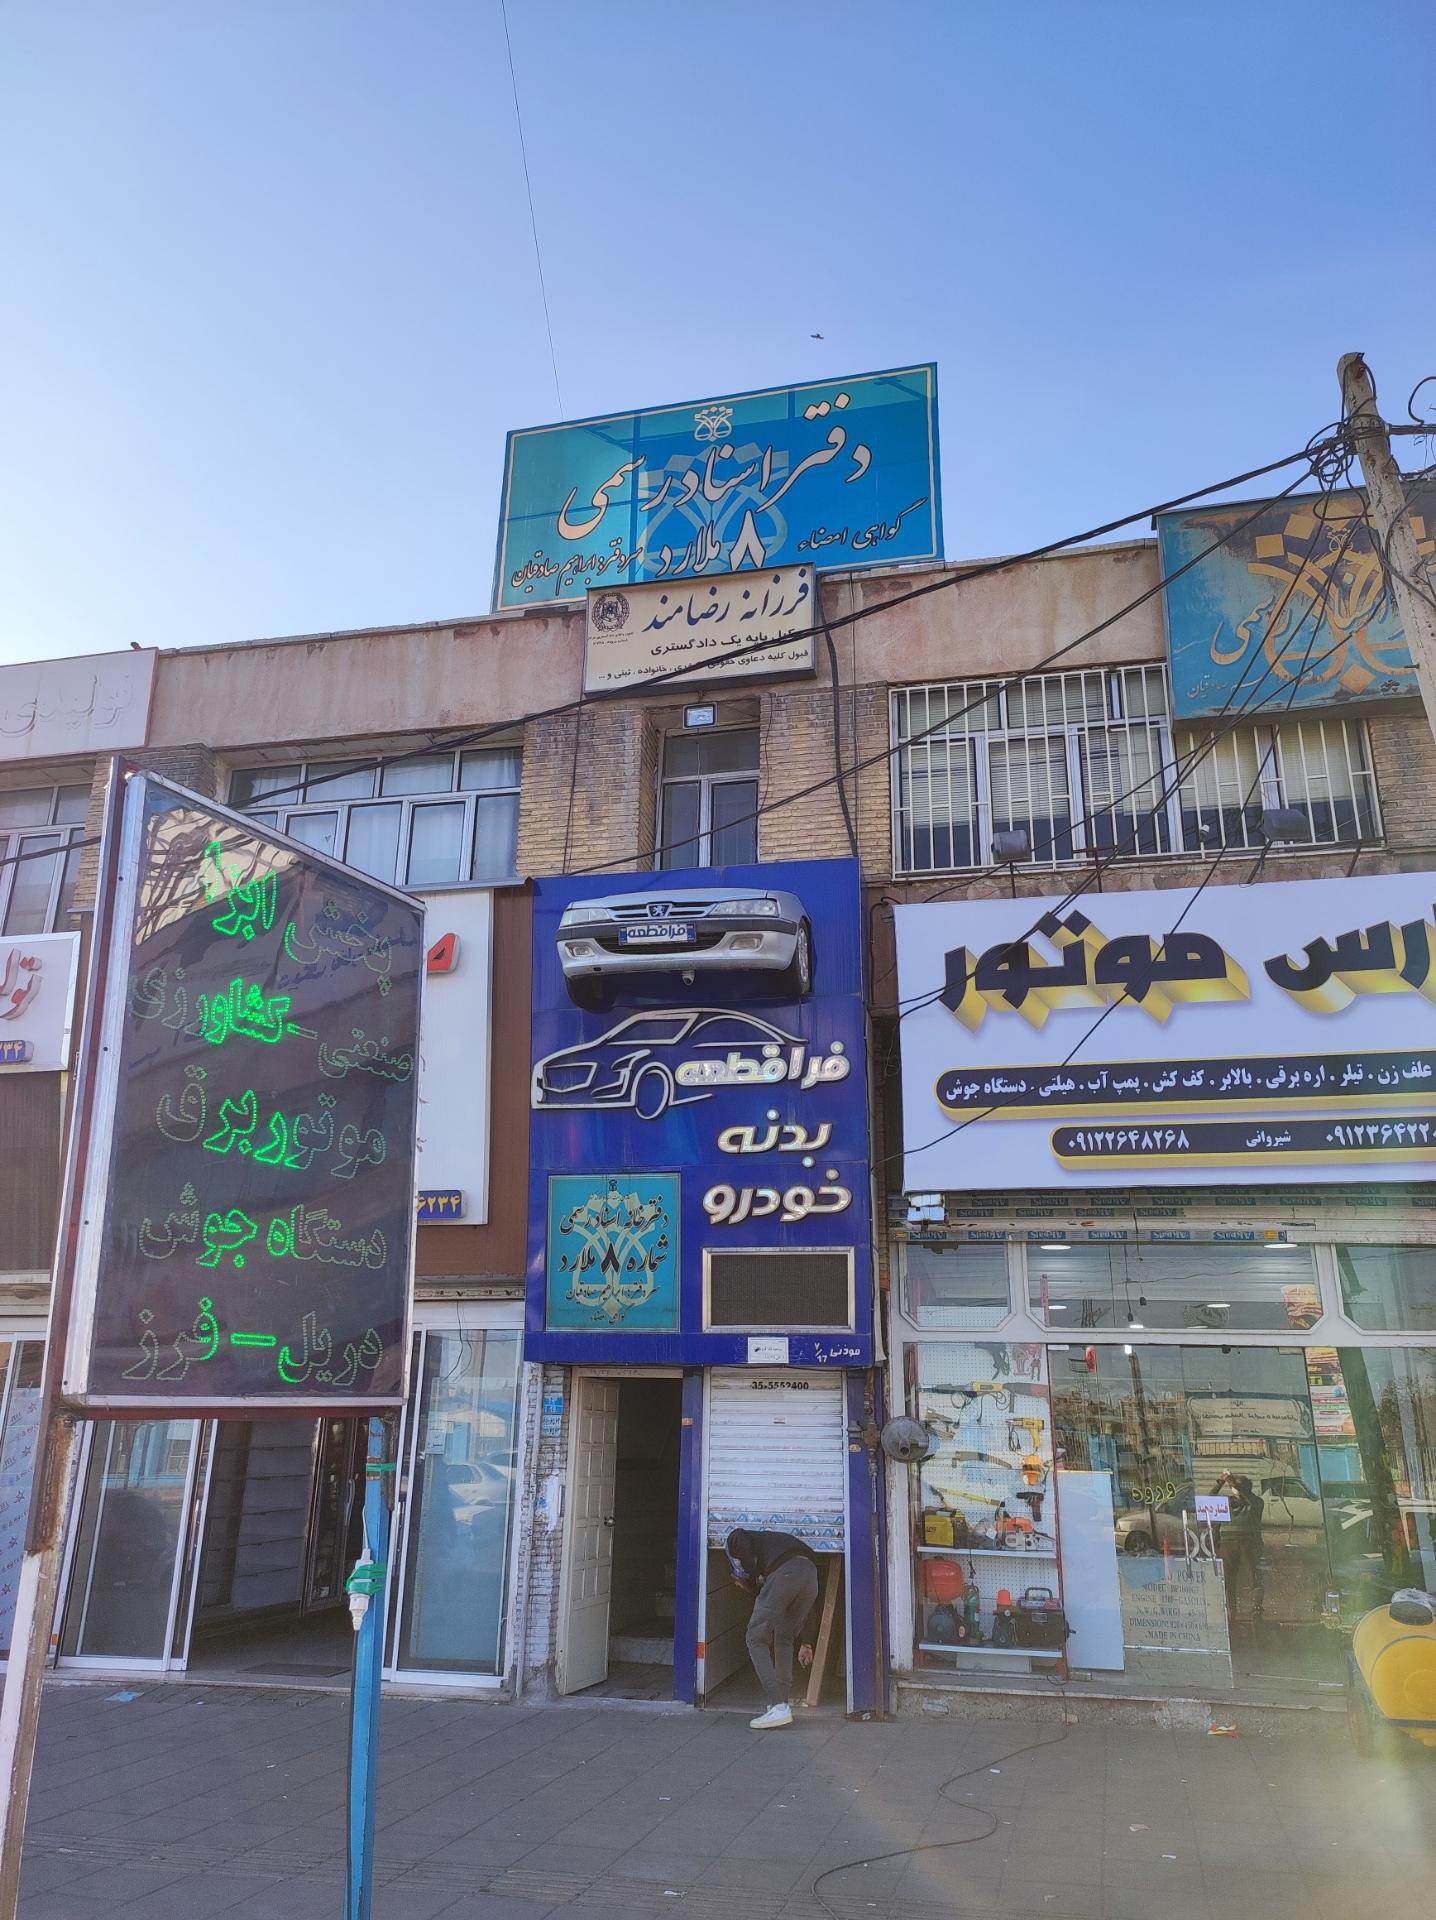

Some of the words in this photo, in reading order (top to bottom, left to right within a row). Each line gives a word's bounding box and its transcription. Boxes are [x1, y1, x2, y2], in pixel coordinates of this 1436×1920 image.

[757, 393, 872, 513] دفتر
[674, 444, 772, 508] اسناد
[557, 453, 673, 541] رسمی
[729, 510, 766, 572] ۸
[853, 497, 928, 550] گواهی
[655, 520, 720, 578] ملارد
[511, 550, 559, 593] صادقیان
[556, 554, 596, 597] ابراهیم
[641, 586, 730, 633] رضامند
[740, 568, 809, 622] فرزانه
[721, 635, 741, 648] یک
[767, 651, 785, 662] کلیه
[788, 649, 809, 661] قبول
[637, 664, 667, 676] خانواده
[738, 654, 765, 667] دعاوی
[284, 898, 392, 997] پخش
[627, 923, 686, 939] فراقطعه
[941, 909, 1240, 1022] موتور
[1264, 904, 1436, 1000] رس
[130, 967, 290, 1044] کشاورزی
[319, 1028, 414, 1081] صنعتی
[675, 1041, 850, 1089] فراقطعه
[1402, 1061, 1432, 1079] علف
[946, 1079, 980, 1101] جوش
[984, 1077, 1027, 1094] دستگاه
[1039, 1073, 1075, 1097] هیلتی
[1087, 1071, 1109, 1090] آب
[1112, 1076, 1140, 1095] پمپ
[1152, 1070, 1178, 1093] کش
[1182, 1069, 1204, 1087] کف
[1219, 1067, 1252, 1091] بالابر
[1266, 1065, 1300, 1089] برقی
[1304, 1065, 1325, 1087] اره
[1340, 1063, 1362, 1086] تیلر
[1377, 1065, 1399, 1084] زن
[156, 1065, 257, 1153] برق
[254, 1093, 386, 1179] موتور
[717, 1108, 833, 1167] بدنه
[1068, 1128, 1190, 1151] ۰۹۱۲۲۶۴۸۲۶۸
[1246, 1130, 1292, 1148] شیروانی
[702, 1168, 852, 1225] خودرو
[139, 1182, 258, 1268] جوش
[267, 1204, 386, 1269] دستگاه
[560, 1205, 591, 1236] رسمی
[559, 1245, 596, 1273] ملارد
[601, 1242, 620, 1276] ۸
[626, 1233, 669, 1272] شماره
[122, 1297, 219, 1380] فرز
[278, 1311, 384, 1386] دریل
[1131, 1481, 1177, 1505] ورود
